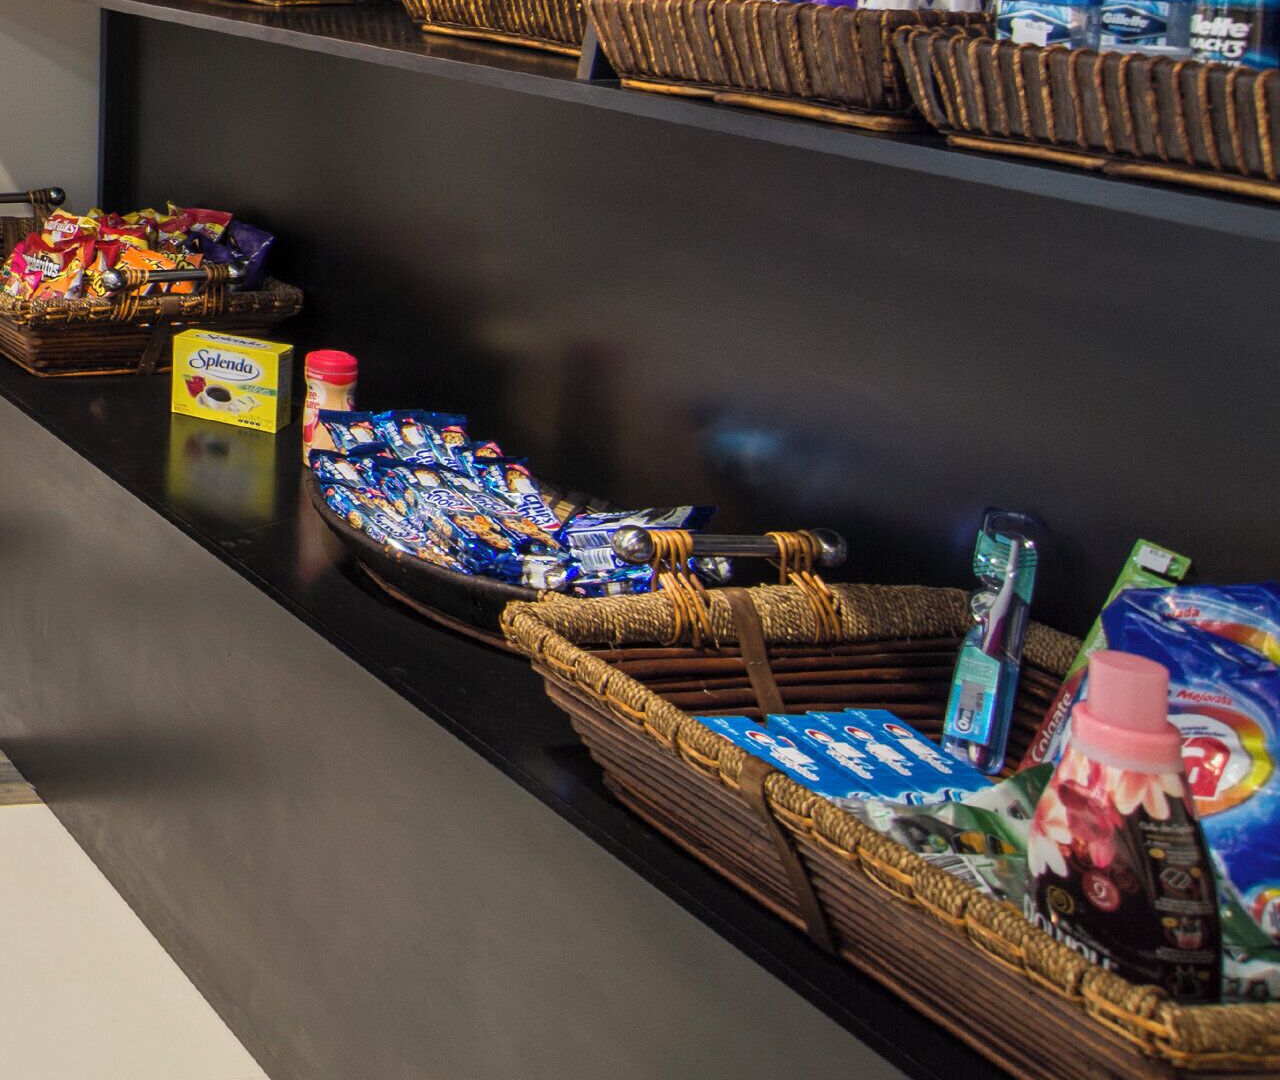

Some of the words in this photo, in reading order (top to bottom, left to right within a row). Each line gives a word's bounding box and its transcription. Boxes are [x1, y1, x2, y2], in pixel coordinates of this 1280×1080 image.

[1102, 12, 1150, 30] Gillette
[189, 349, 254, 374] Splenda
[1031, 691, 1072, 762] Colgate
